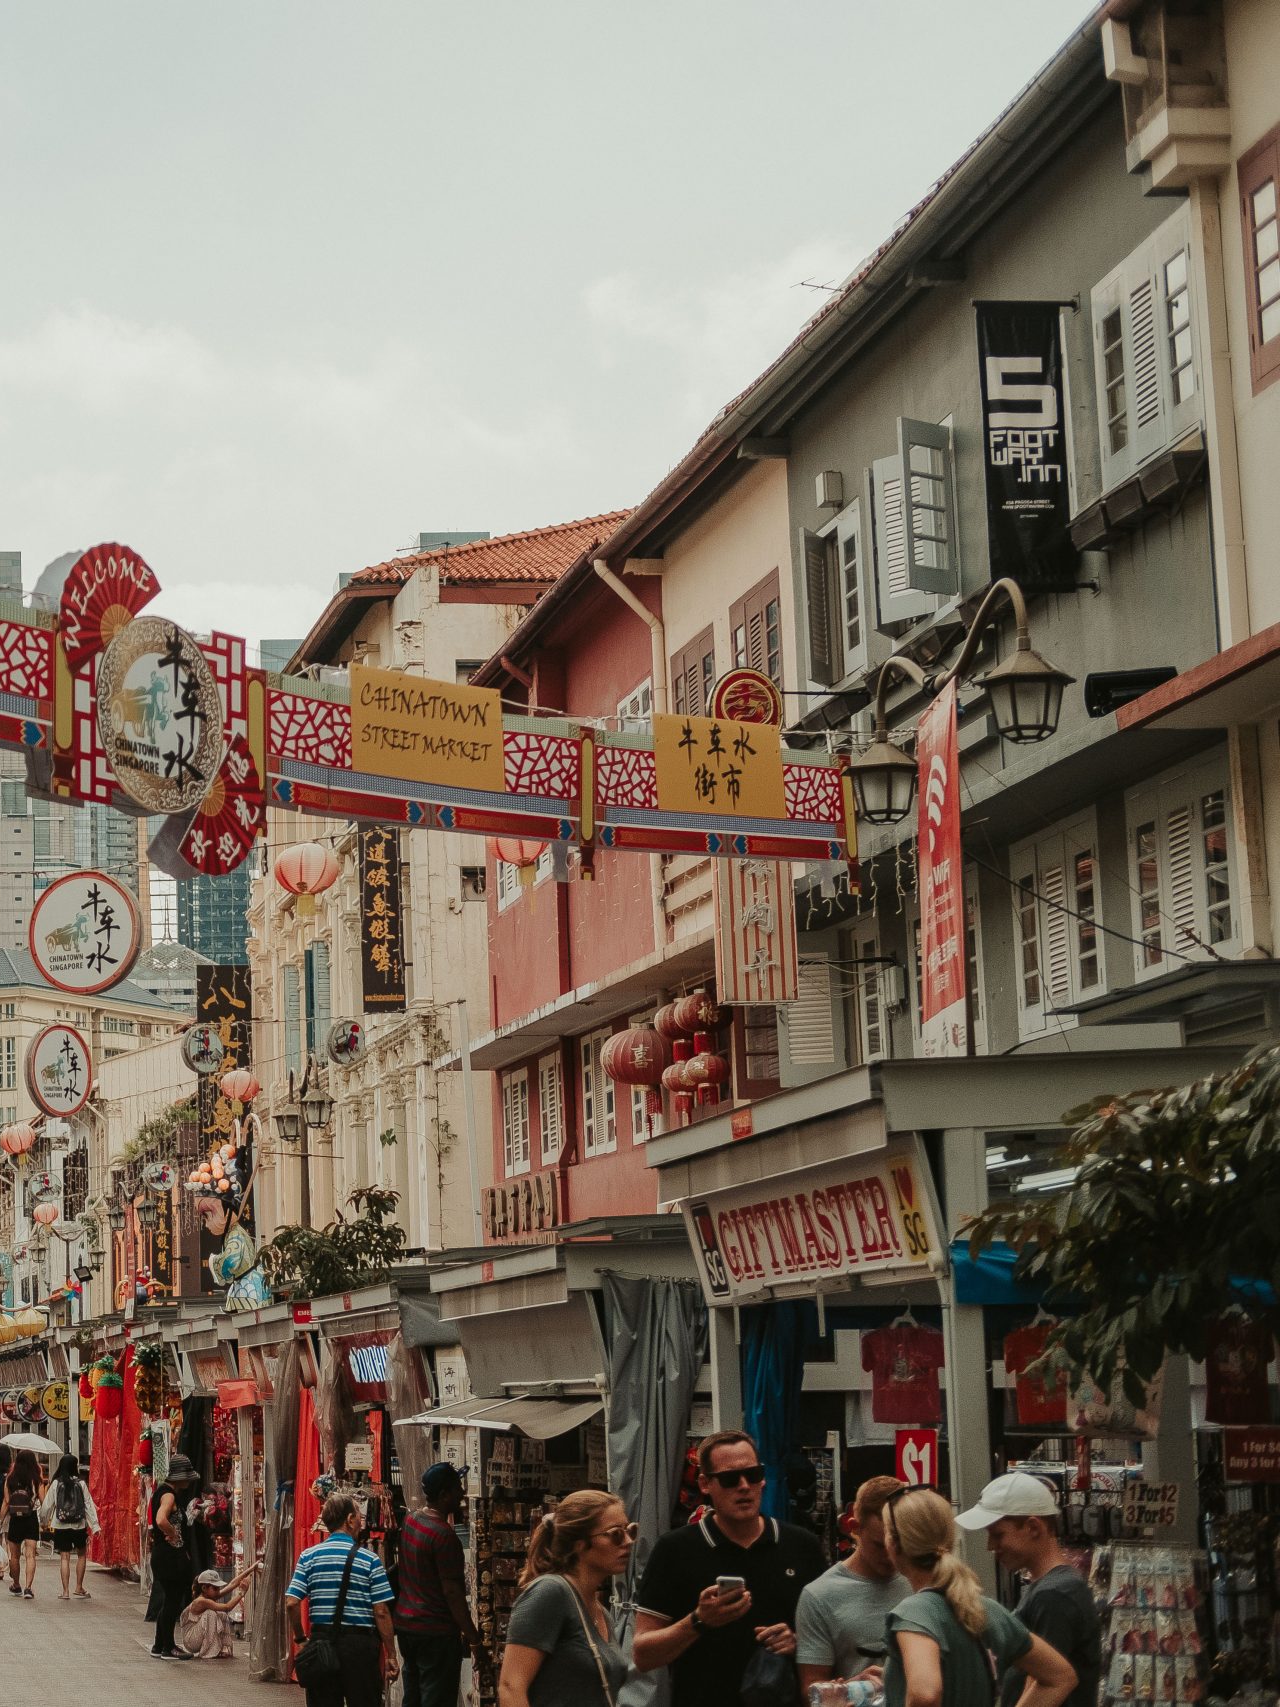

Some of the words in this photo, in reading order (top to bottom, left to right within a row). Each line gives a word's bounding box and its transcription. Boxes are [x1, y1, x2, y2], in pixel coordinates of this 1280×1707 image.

[985, 356, 1058, 428] 5
[989, 429, 1059, 448] FOOT
[990, 447, 1044, 466] WAY
[64, 555, 153, 651] WELCOME
[360, 681, 490, 728] CHINATOWN
[114, 737, 160, 760] CHINATOWN
[361, 723, 420, 752] STREET
[421, 735, 493, 762] MARKET
[114, 753, 160, 775] SINGAPORE
[49, 952, 84, 963] CHINATOWN
[49, 961, 84, 972] SINGAPORE
[718, 1175, 903, 1283] GIFTMASTER
[903, 1211, 929, 1256] SG
[705, 1251, 726, 1287] SG
[901, 1437, 932, 1487] $1
[1229, 1456, 1249, 1469] Any
[1250, 1456, 1258, 1468] 3
[1128, 1483, 1137, 1500] 1
[1137, 1484, 1160, 1503] For
[1160, 1483, 1178, 1503] $2
[1125, 1505, 1136, 1523] 3
[1136, 1507, 1159, 1525] For
[1159, 1506, 1176, 1525] $5
